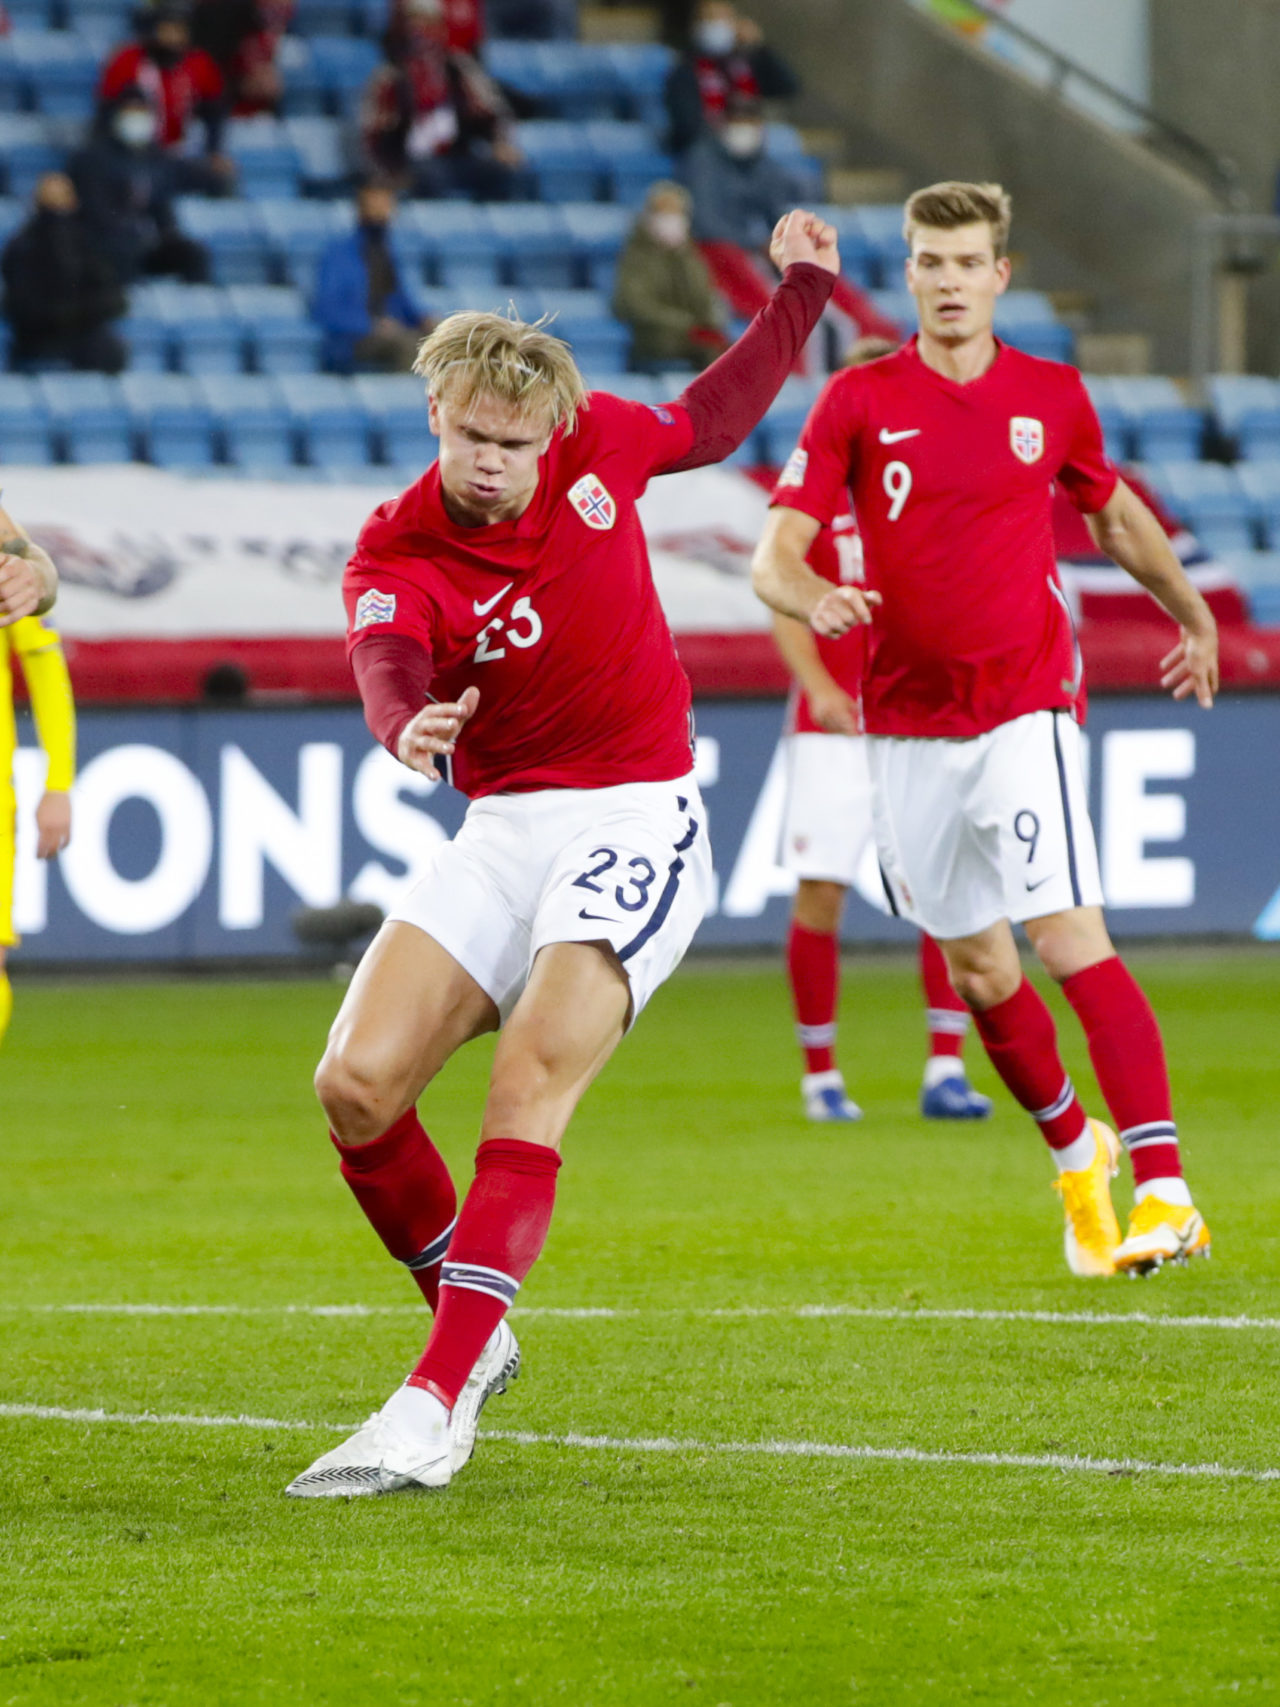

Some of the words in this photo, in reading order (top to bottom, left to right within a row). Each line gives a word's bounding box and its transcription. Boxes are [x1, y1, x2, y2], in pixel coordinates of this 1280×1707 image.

[882, 460, 912, 521] 9
[473, 596, 543, 664] 23
[1014, 809, 1040, 864] 9
[571, 847, 657, 912] 23
